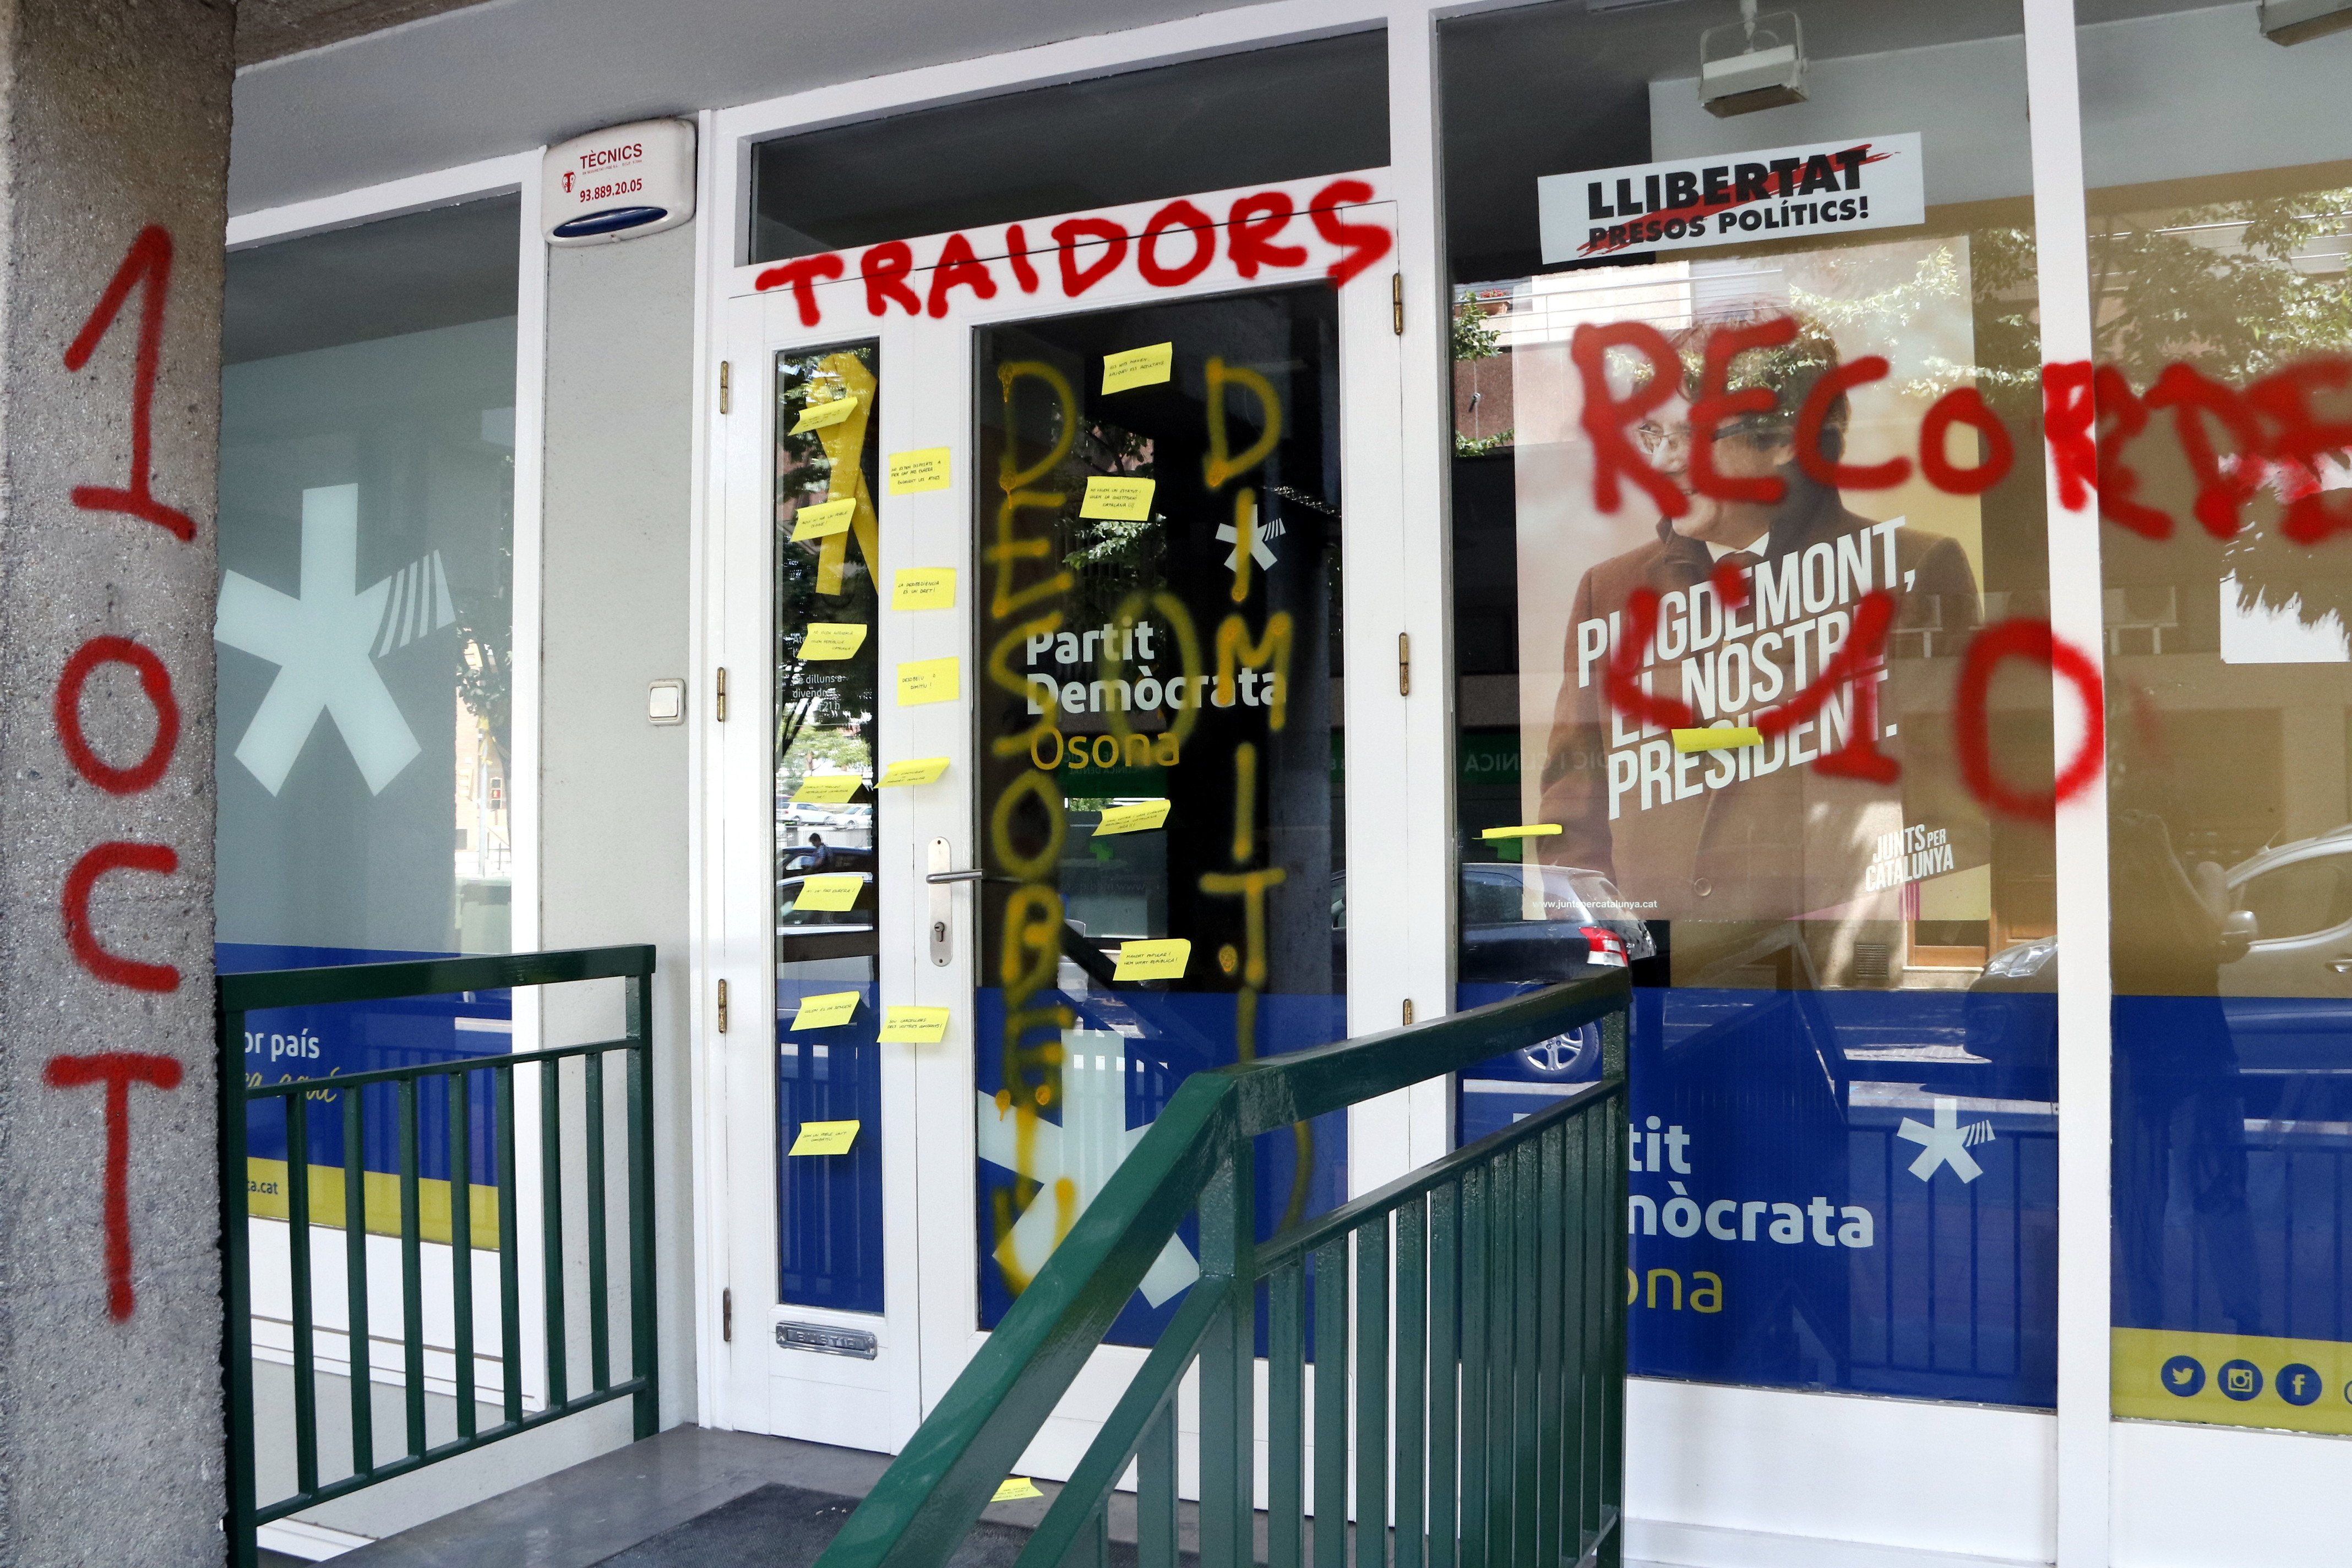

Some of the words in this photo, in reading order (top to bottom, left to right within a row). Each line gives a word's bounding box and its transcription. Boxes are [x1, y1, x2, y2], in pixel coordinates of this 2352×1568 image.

[580, 143, 643, 169] TÈCNICS
[580, 178, 643, 203] 93.889.20.05
[1587, 148, 1869, 220] LLIBERTAT
[1588, 215, 1707, 249] PRESOS
[1718, 195, 1869, 235] POLÍTICS!
[755, 179, 1393, 327] TRAIDORS
[1026, 615, 1155, 666] Partit
[805, 673, 835, 684] dilluns
[1026, 665, 1287, 716] Demòcrata
[1030, 725, 1180, 771] Osona
[1873, 824, 1926, 864] JUNTS
[1926, 829, 1946, 850] PER
[1865, 843, 1954, 893] CATALUNYA
[1532, 899, 1658, 910] www.juntspercatalunya.cat
[271, 1028, 320, 1062] país
